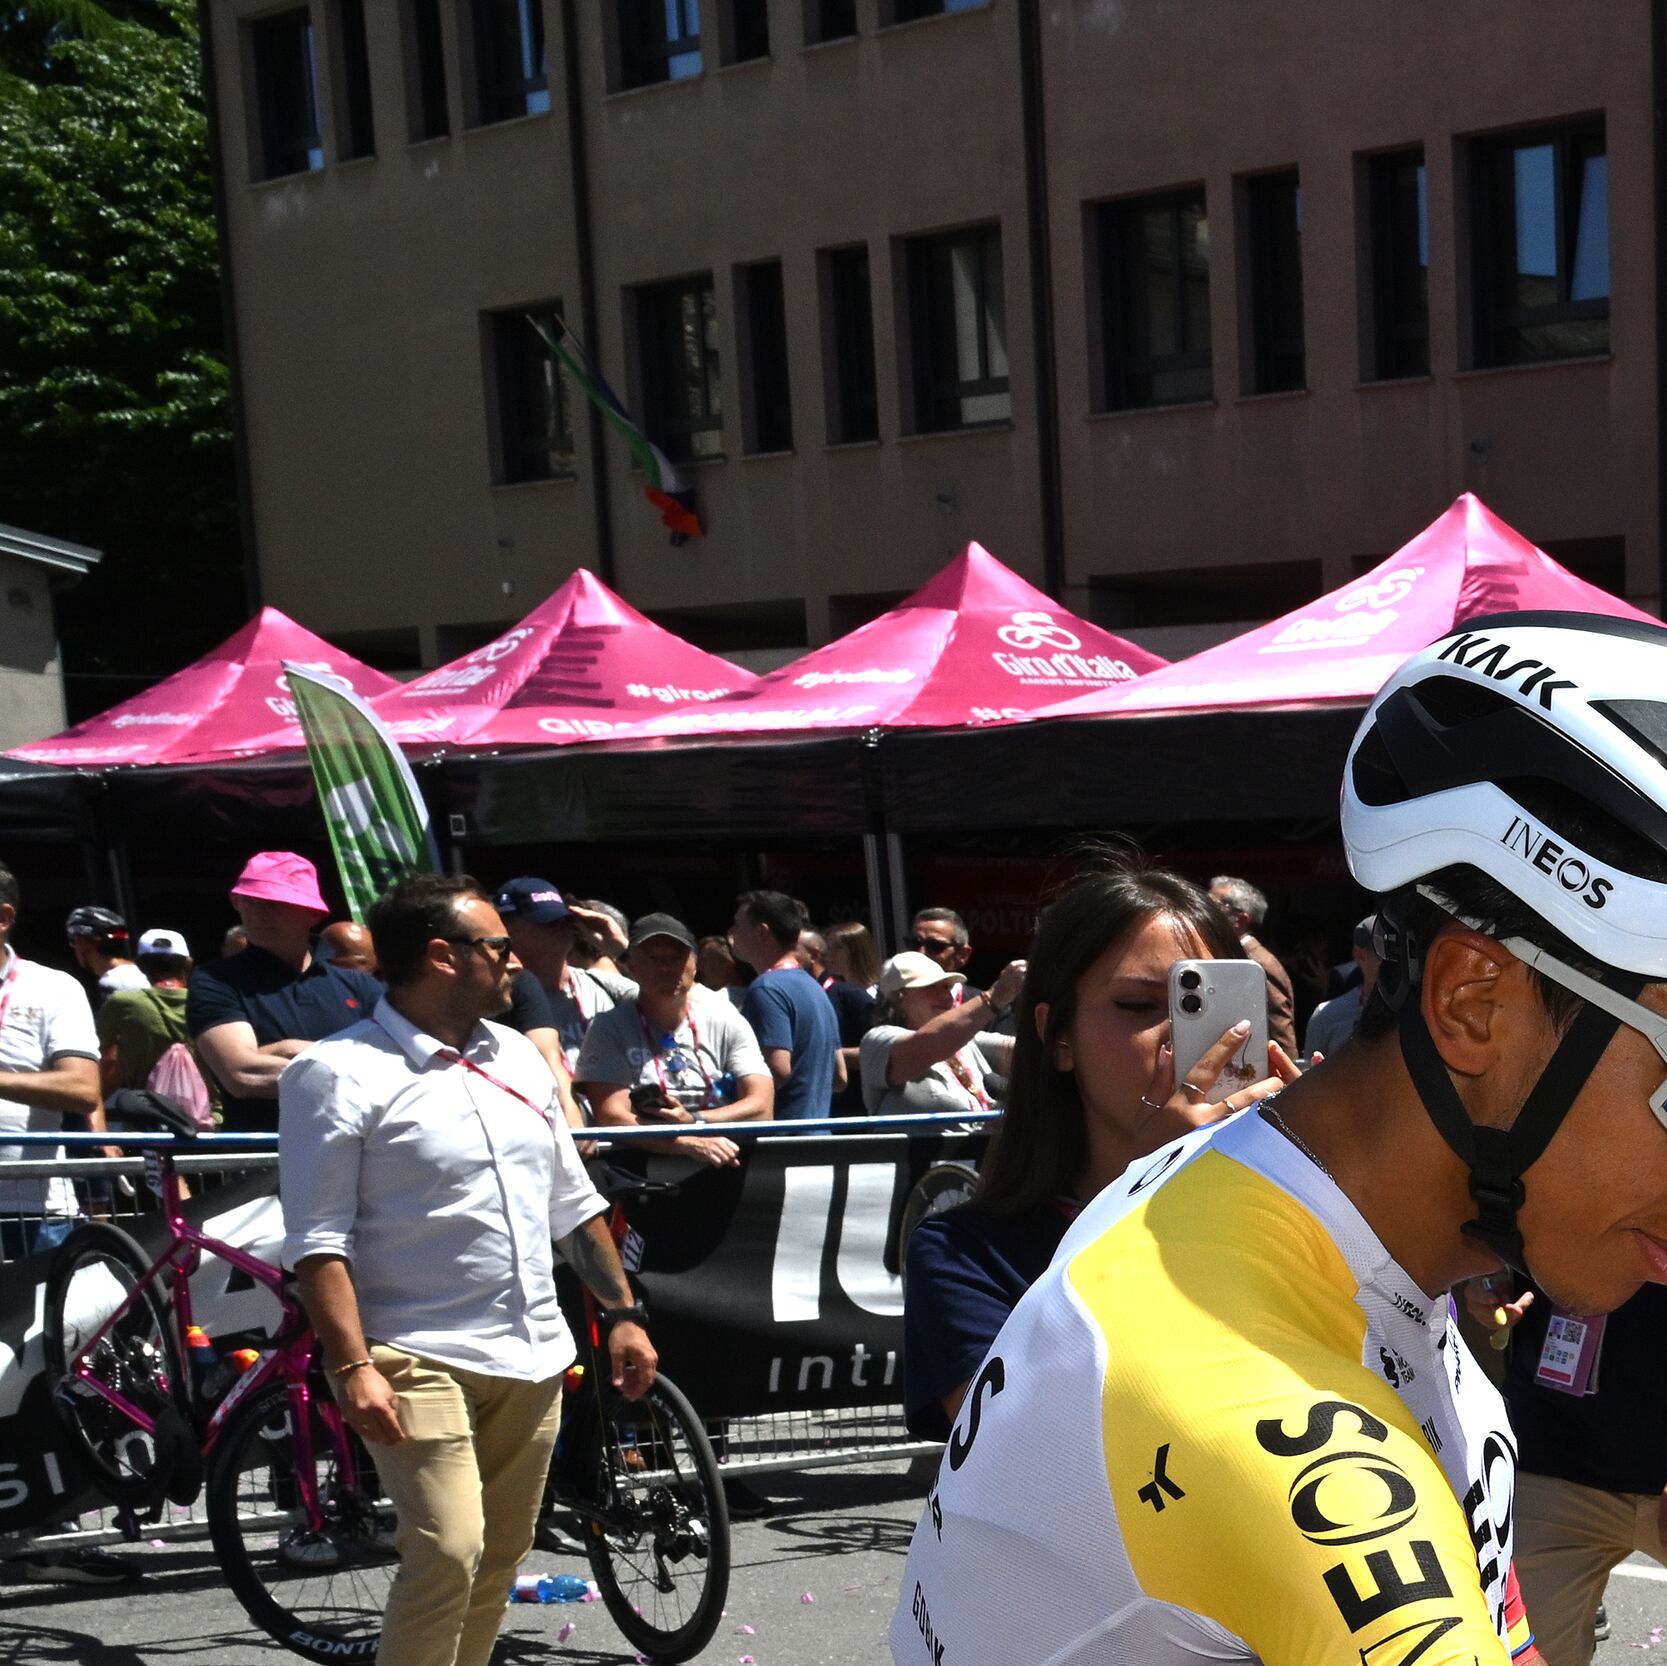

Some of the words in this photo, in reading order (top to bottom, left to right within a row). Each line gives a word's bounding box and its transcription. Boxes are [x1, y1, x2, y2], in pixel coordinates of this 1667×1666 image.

[992, 651, 1050, 677] Giro
[1437, 632, 1579, 711] KASK
[1499, 814, 1614, 910] INEOS
